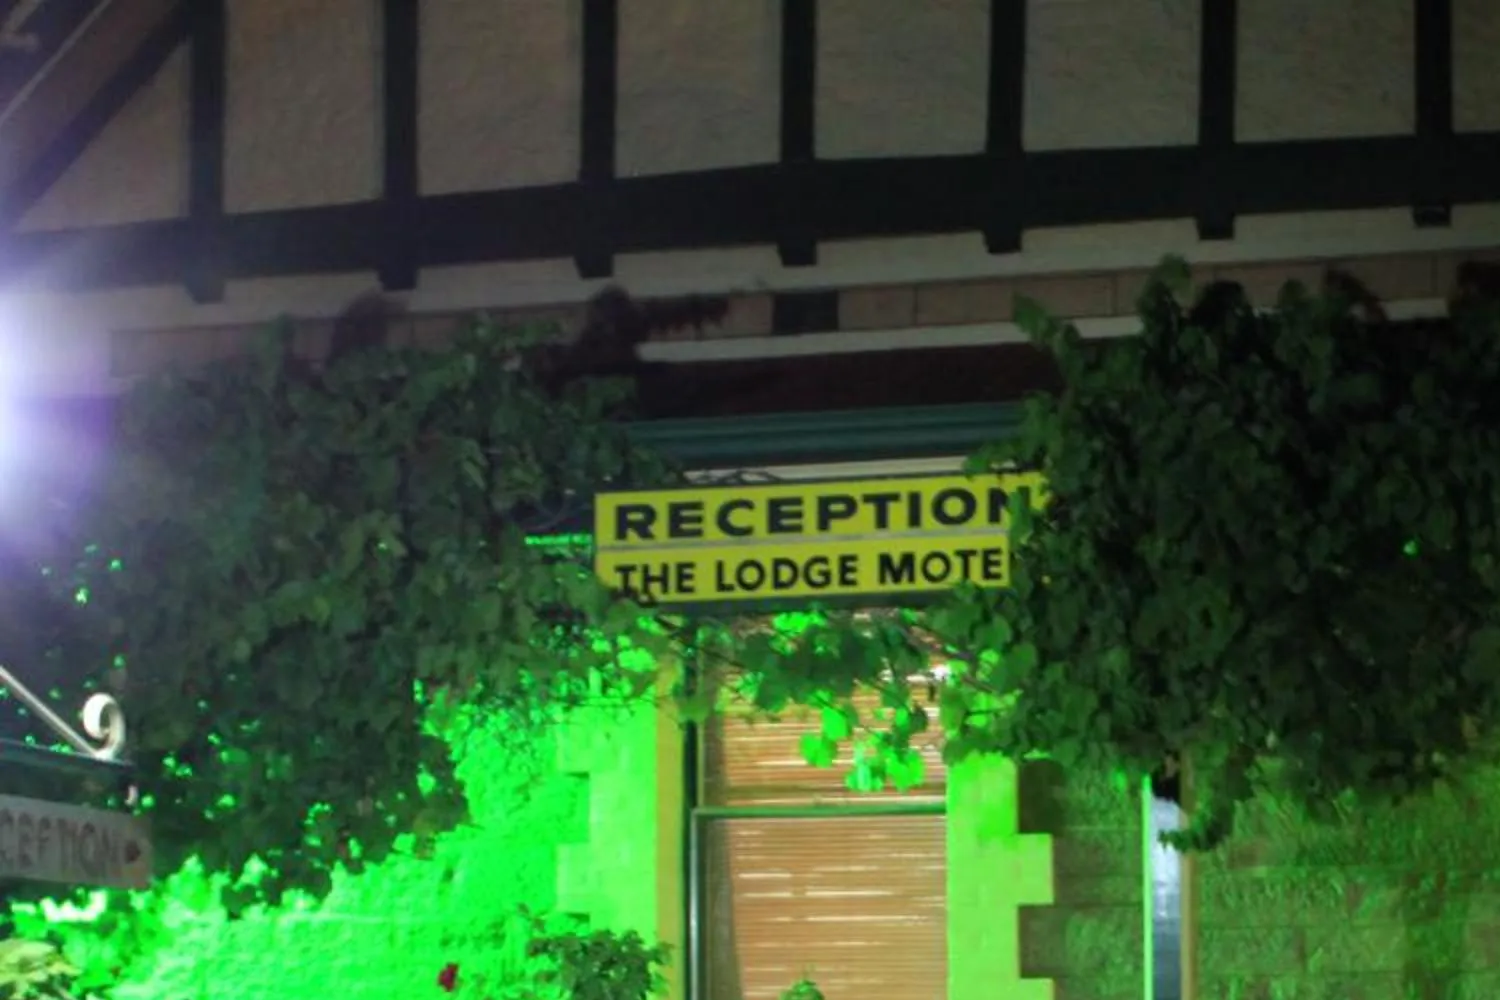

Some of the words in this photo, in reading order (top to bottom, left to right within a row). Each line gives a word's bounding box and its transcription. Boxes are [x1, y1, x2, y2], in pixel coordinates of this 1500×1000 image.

[615, 485, 1031, 540] RECEPTION
[614, 561, 696, 597] THE
[716, 554, 859, 593] LODGE
[877, 548, 1003, 585] MOTE
